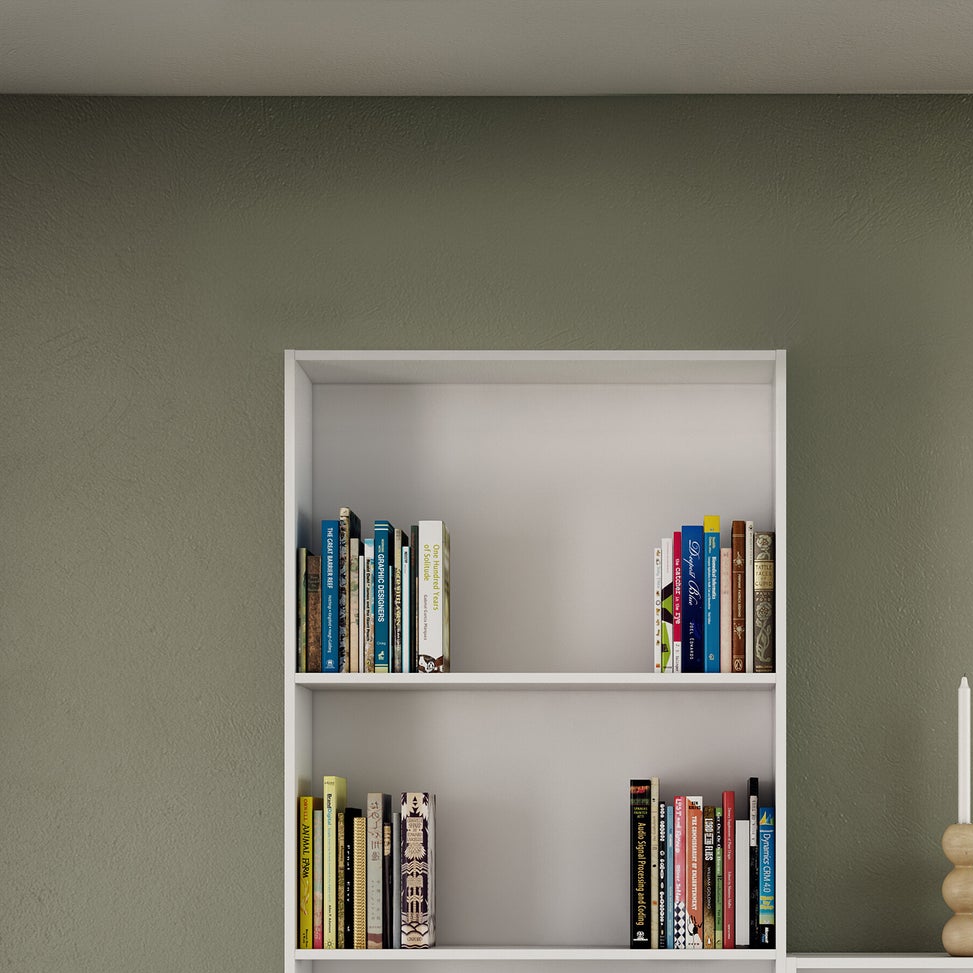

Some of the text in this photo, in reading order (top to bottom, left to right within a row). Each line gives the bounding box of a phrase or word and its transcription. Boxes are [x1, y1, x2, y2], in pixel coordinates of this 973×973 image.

[683, 540, 702, 606] Deepest Blue
[705, 818, 713, 832] LORD
[302, 824, 310, 878] ANIMAL FARM
[705, 846, 713, 860] FLIES
[763, 834, 771, 864] Dynamics
[636, 822, 646, 926] Audio Signal Processing and Coding
